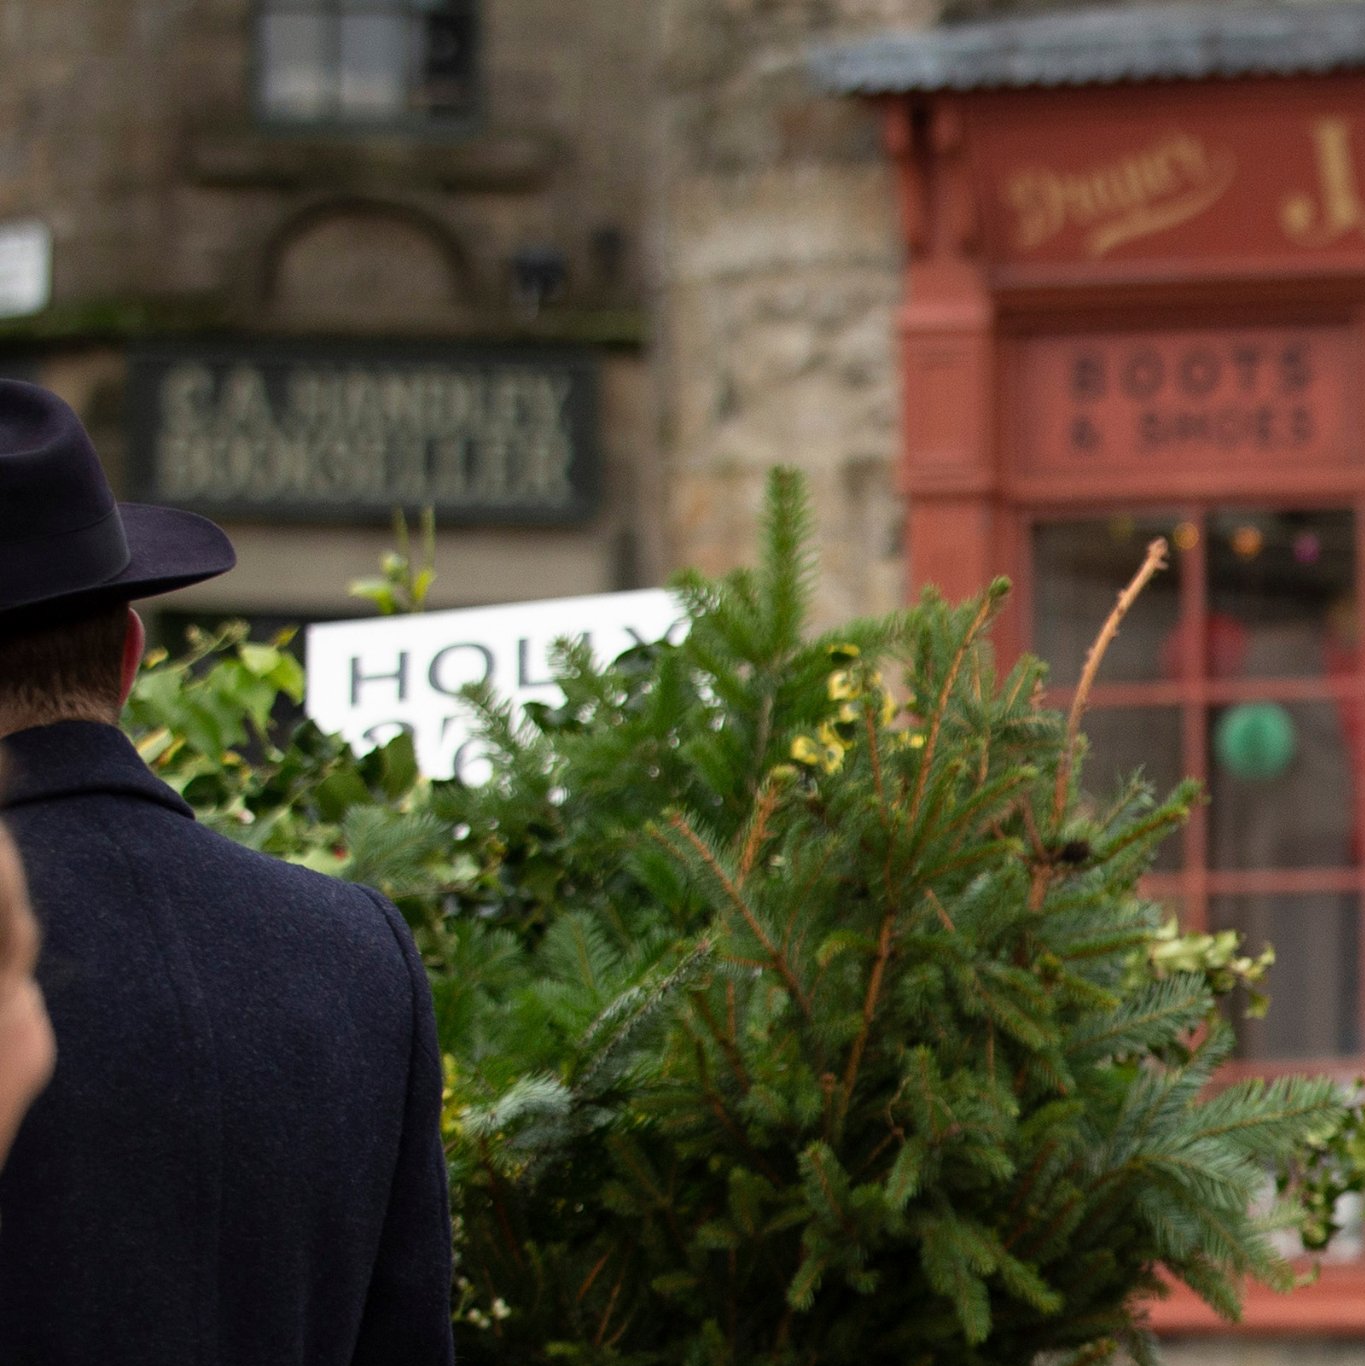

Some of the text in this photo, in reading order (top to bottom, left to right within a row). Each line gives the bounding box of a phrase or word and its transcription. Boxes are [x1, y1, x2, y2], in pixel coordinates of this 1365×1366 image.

[1070, 343, 1312, 399] BOOTS
[1070, 403, 1312, 454] & SHOES
[349, 626, 686, 707] HOL
